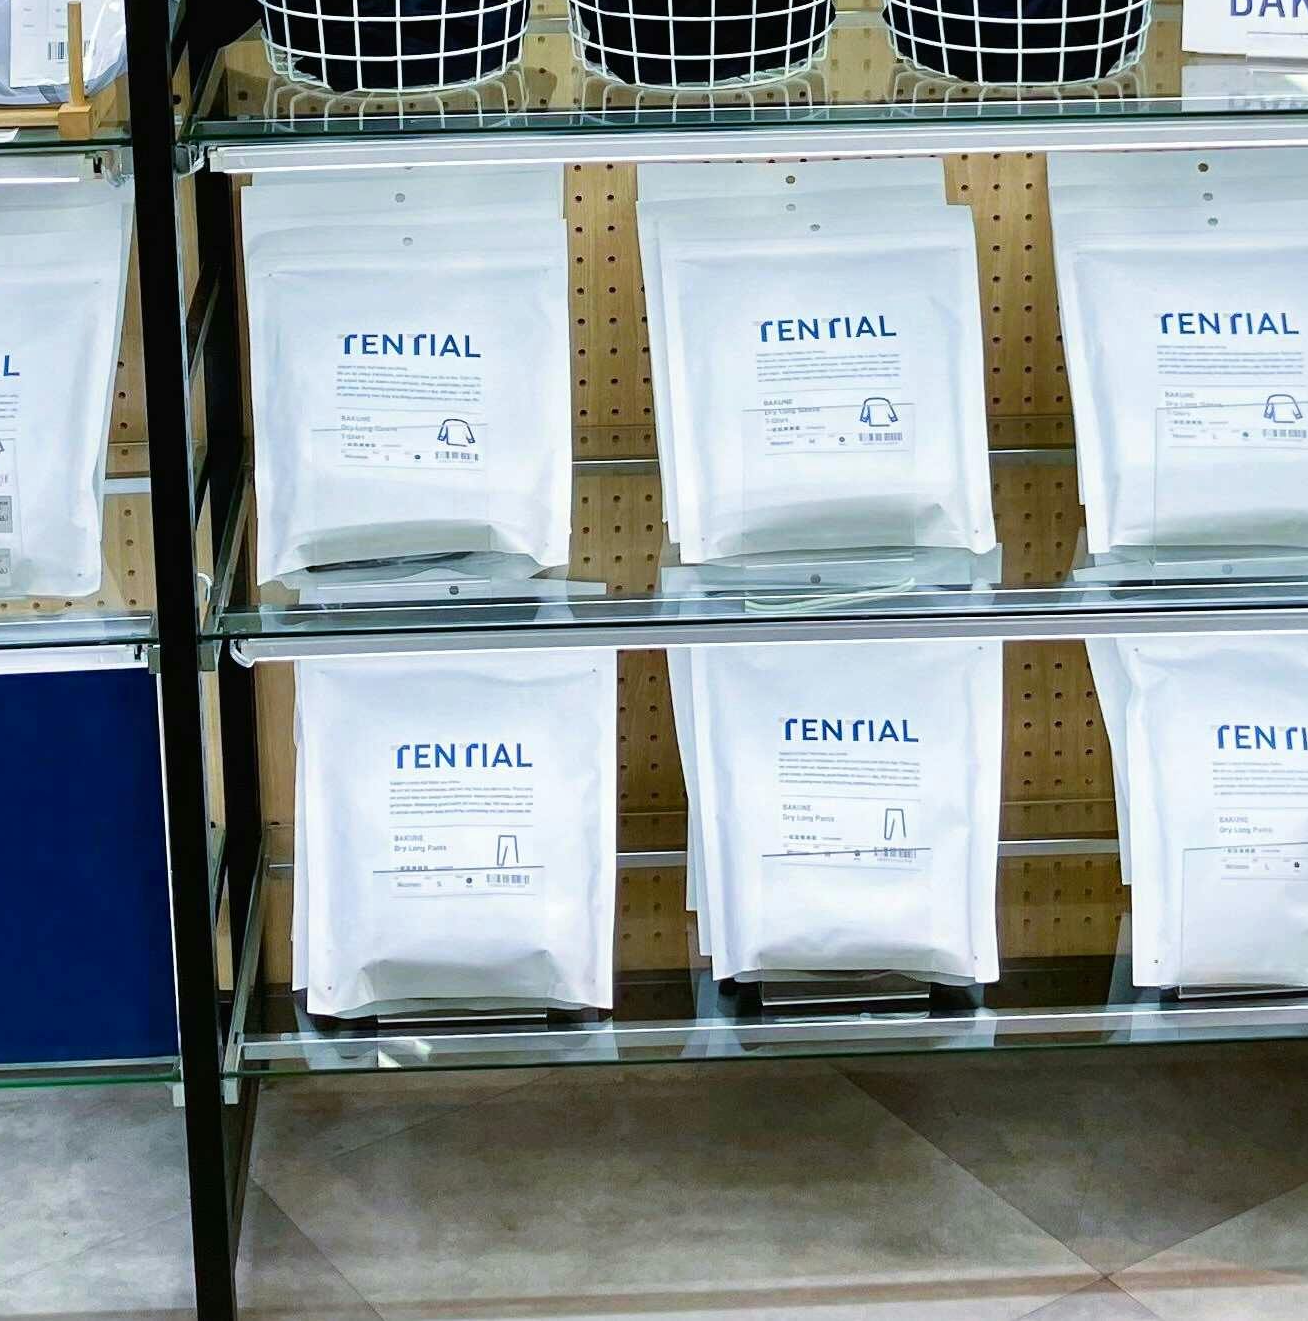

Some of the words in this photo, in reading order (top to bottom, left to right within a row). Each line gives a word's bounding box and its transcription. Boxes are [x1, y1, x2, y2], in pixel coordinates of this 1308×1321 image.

[753, 315, 897, 342] TENTIAL
[1154, 312, 1300, 336] TENTIAL
[337, 333, 482, 358] TENTIAL
[779, 718, 919, 743] TENTIAL
[390, 742, 534, 769] TENTIAL
